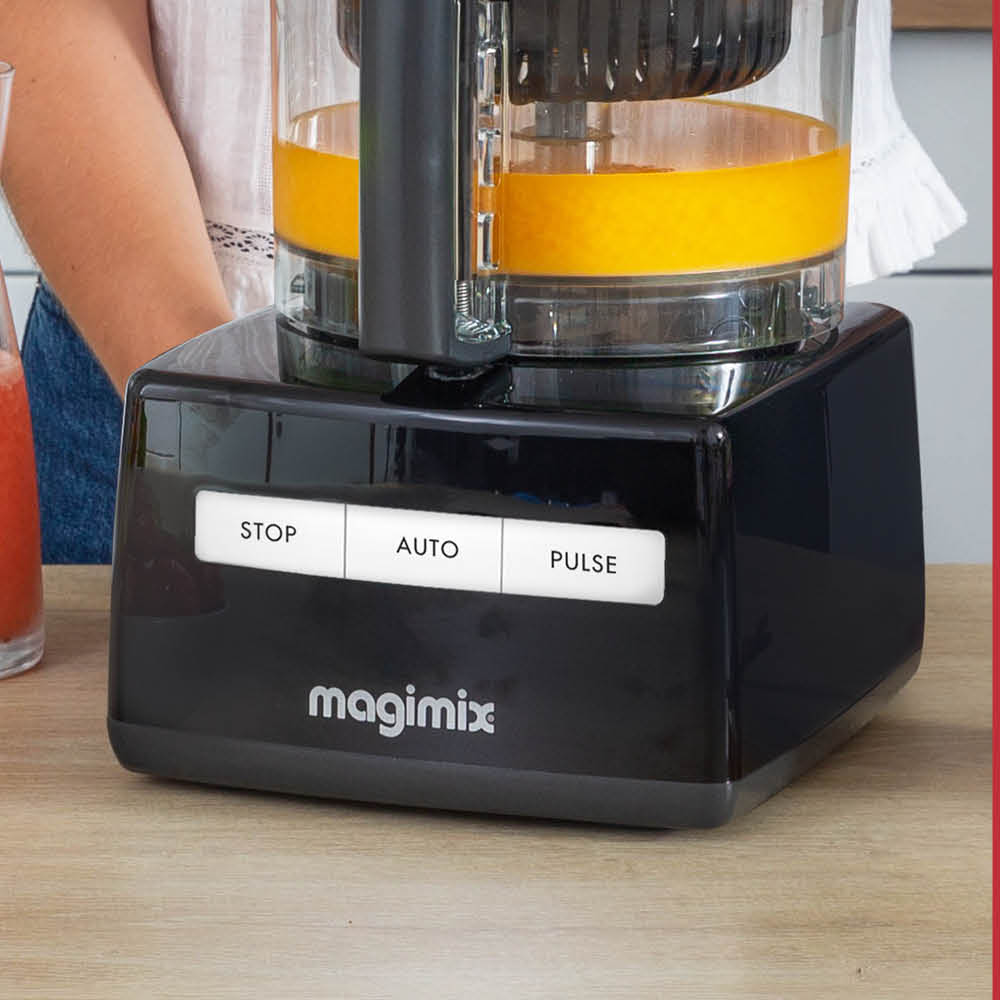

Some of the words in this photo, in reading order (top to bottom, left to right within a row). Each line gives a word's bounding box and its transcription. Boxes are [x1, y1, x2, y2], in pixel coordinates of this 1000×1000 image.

[240, 520, 297, 543] STOP
[396, 536, 459, 559] AUTO
[551, 550, 617, 574] PULSE
[308, 684, 495, 738] magimix
